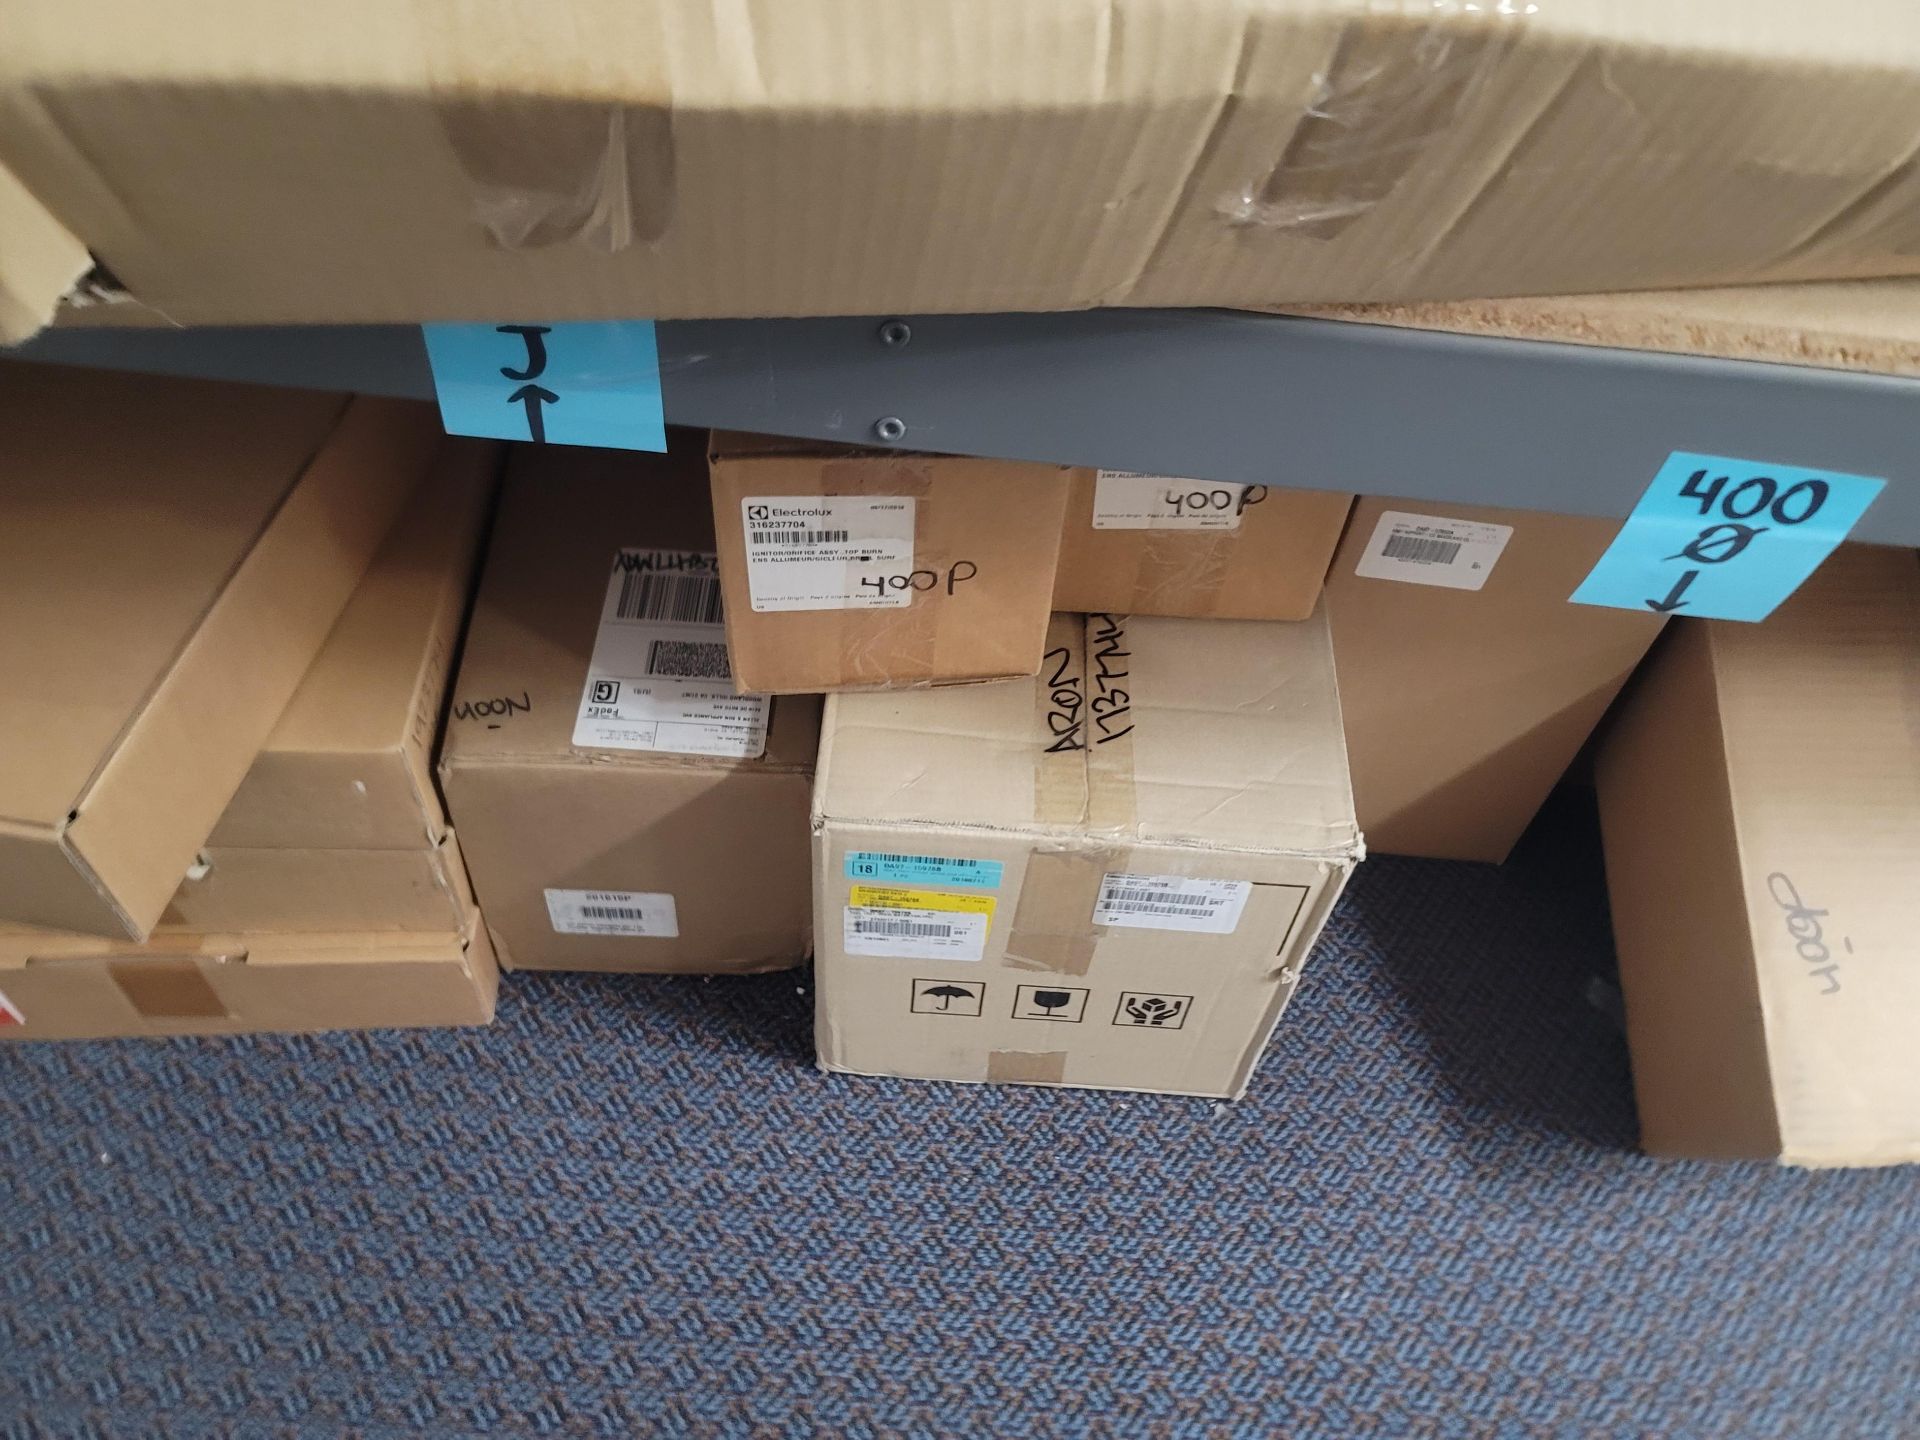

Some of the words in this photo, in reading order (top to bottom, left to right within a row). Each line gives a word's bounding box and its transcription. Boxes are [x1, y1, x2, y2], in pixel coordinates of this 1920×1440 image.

[496, 325, 552, 380] J
[1165, 484, 1268, 517] 400P
[1678, 469, 1830, 525] 400
[772, 508, 833, 517] Electrolux
[749, 521, 806, 529] 316237704
[861, 561, 978, 596] 400P
[596, 683, 613, 701] G
[588, 707, 620, 718] FedEx
[858, 864, 873, 874] 18
